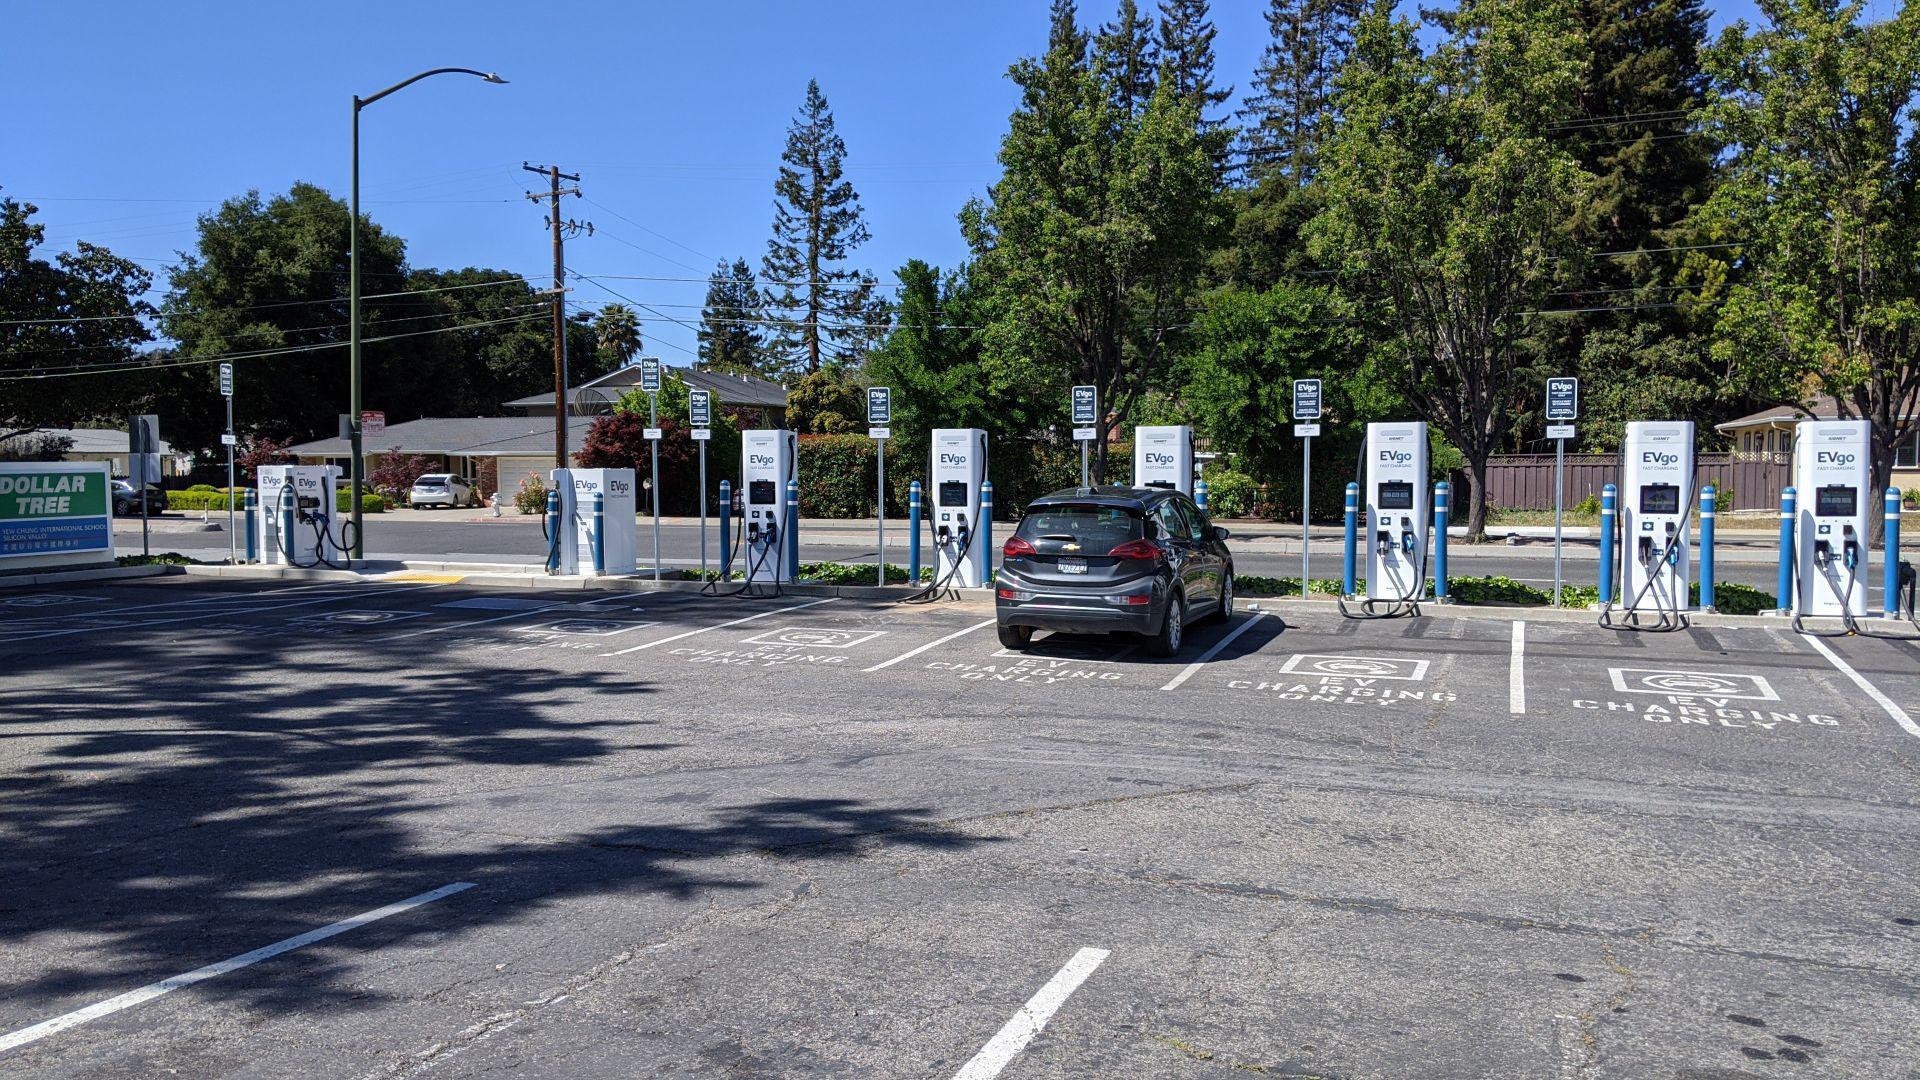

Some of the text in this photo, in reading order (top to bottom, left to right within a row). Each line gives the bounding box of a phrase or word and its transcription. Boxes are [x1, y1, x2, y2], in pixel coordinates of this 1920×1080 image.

[1298, 384, 1317, 392] EVgo
[1551, 382, 1573, 391] EVgo
[750, 455, 774, 466] EVgo
[940, 454, 966, 465] EVgo
[1146, 453, 1174, 465] EVgo
[1380, 450, 1412, 463] EVgo
[1643, 452, 1678, 465] EVgo
[1818, 452, 1855, 465] EVgo
[0, 475, 86, 495] DOLLAR
[262, 476, 281, 486] EVgo
[299, 479, 316, 488] EVgo
[575, 480, 597, 491] EVgo
[610, 481, 629, 494] EVgo
[16, 496, 71, 515] TREE
[40, 525, 83, 533] INTERNATIONAL
[1015, 659, 1070, 668] EV
[925, 662, 1125, 680] CHARGING
[960, 672, 1068, 684] ONLY
[1319, 677, 1376, 687] EV
[1227, 680, 1457, 701] CHARGING
[1278, 692, 1398, 706] ONLY
[1668, 695, 1729, 707] EV
[1572, 699, 1839, 726] CHARGING
[1643, 714, 1777, 729] ONLY
